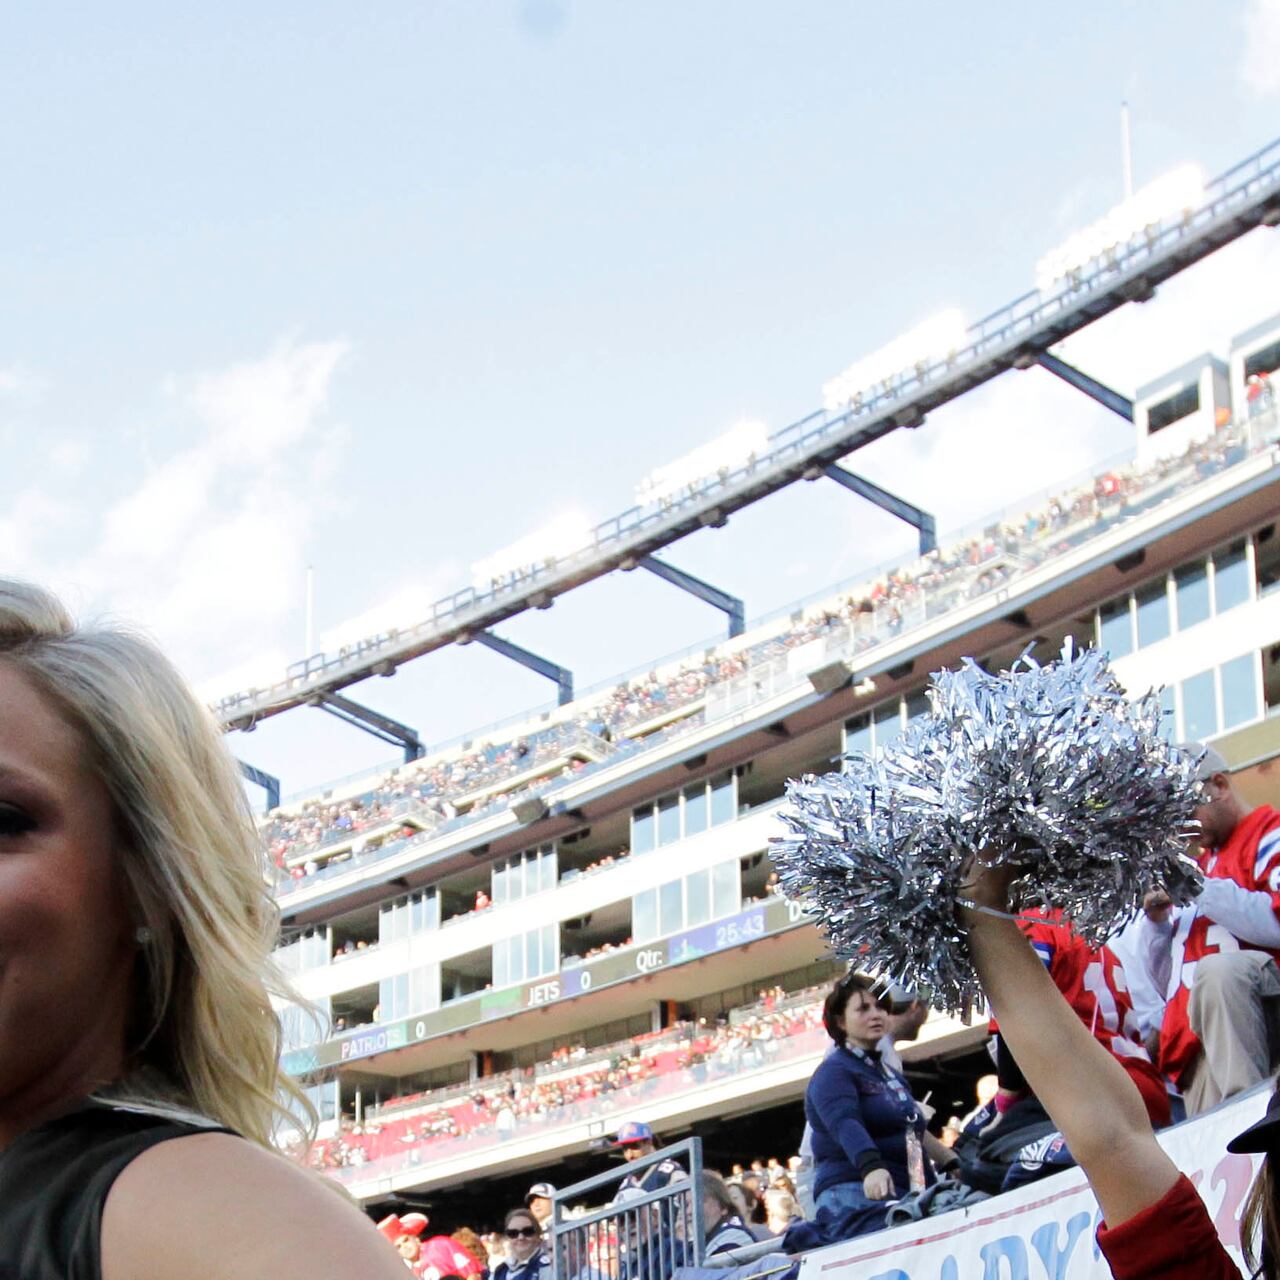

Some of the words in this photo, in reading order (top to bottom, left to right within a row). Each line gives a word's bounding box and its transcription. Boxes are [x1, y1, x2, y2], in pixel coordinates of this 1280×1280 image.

[340, 1028, 402, 1061] PATRIOTS
[415, 1020, 426, 1040] 0
[526, 980, 561, 1007] JETS
[580, 971, 592, 991] 0
[636, 949, 663, 972] Qtr:
[715, 914, 765, 946] 25:43
